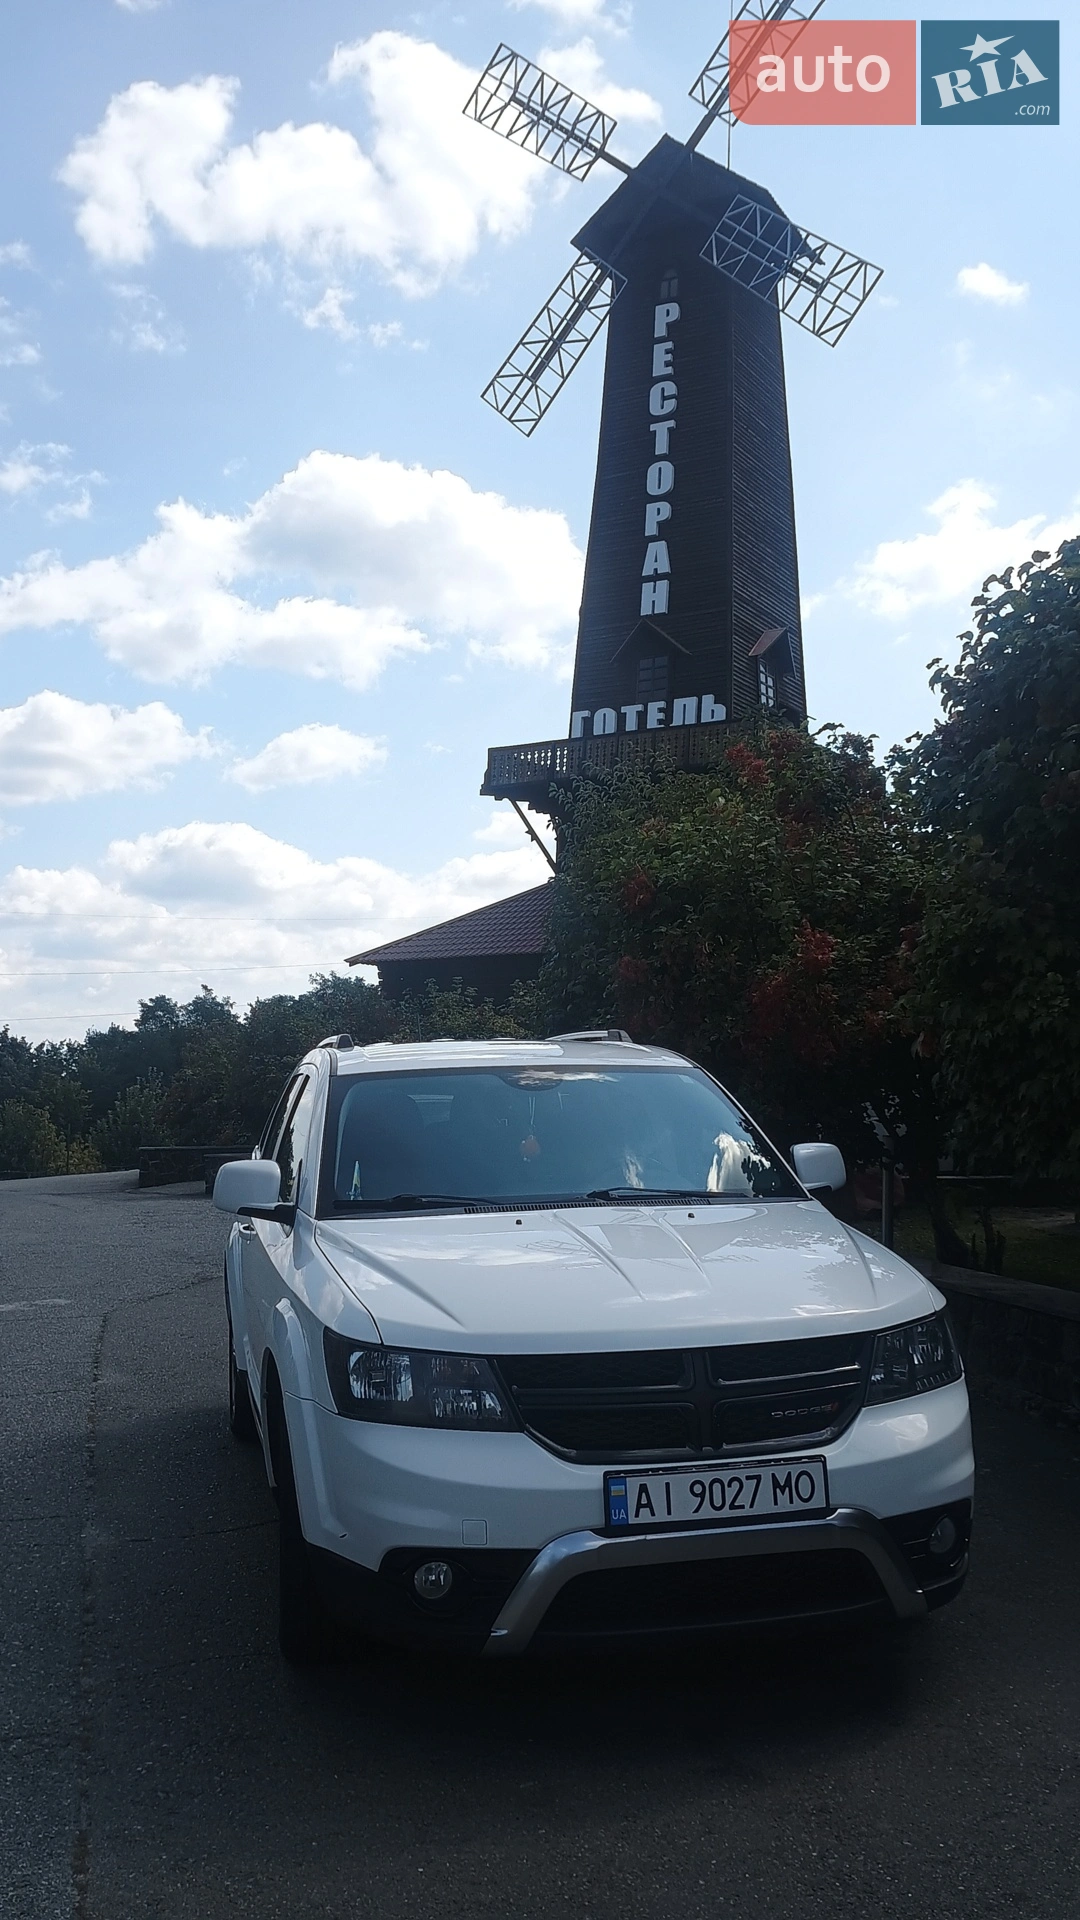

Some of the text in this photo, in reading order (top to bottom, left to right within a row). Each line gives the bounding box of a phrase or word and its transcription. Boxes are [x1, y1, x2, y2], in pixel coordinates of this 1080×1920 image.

[640, 302, 681, 616] РЕСТОРАН
[571, 694, 727, 739] ГОТЕЛЬ
[771, 1403, 834, 1418] DODGE
[611, 1509, 627, 1521] UA
[634, 1469, 816, 1518] AI 9027 MO
